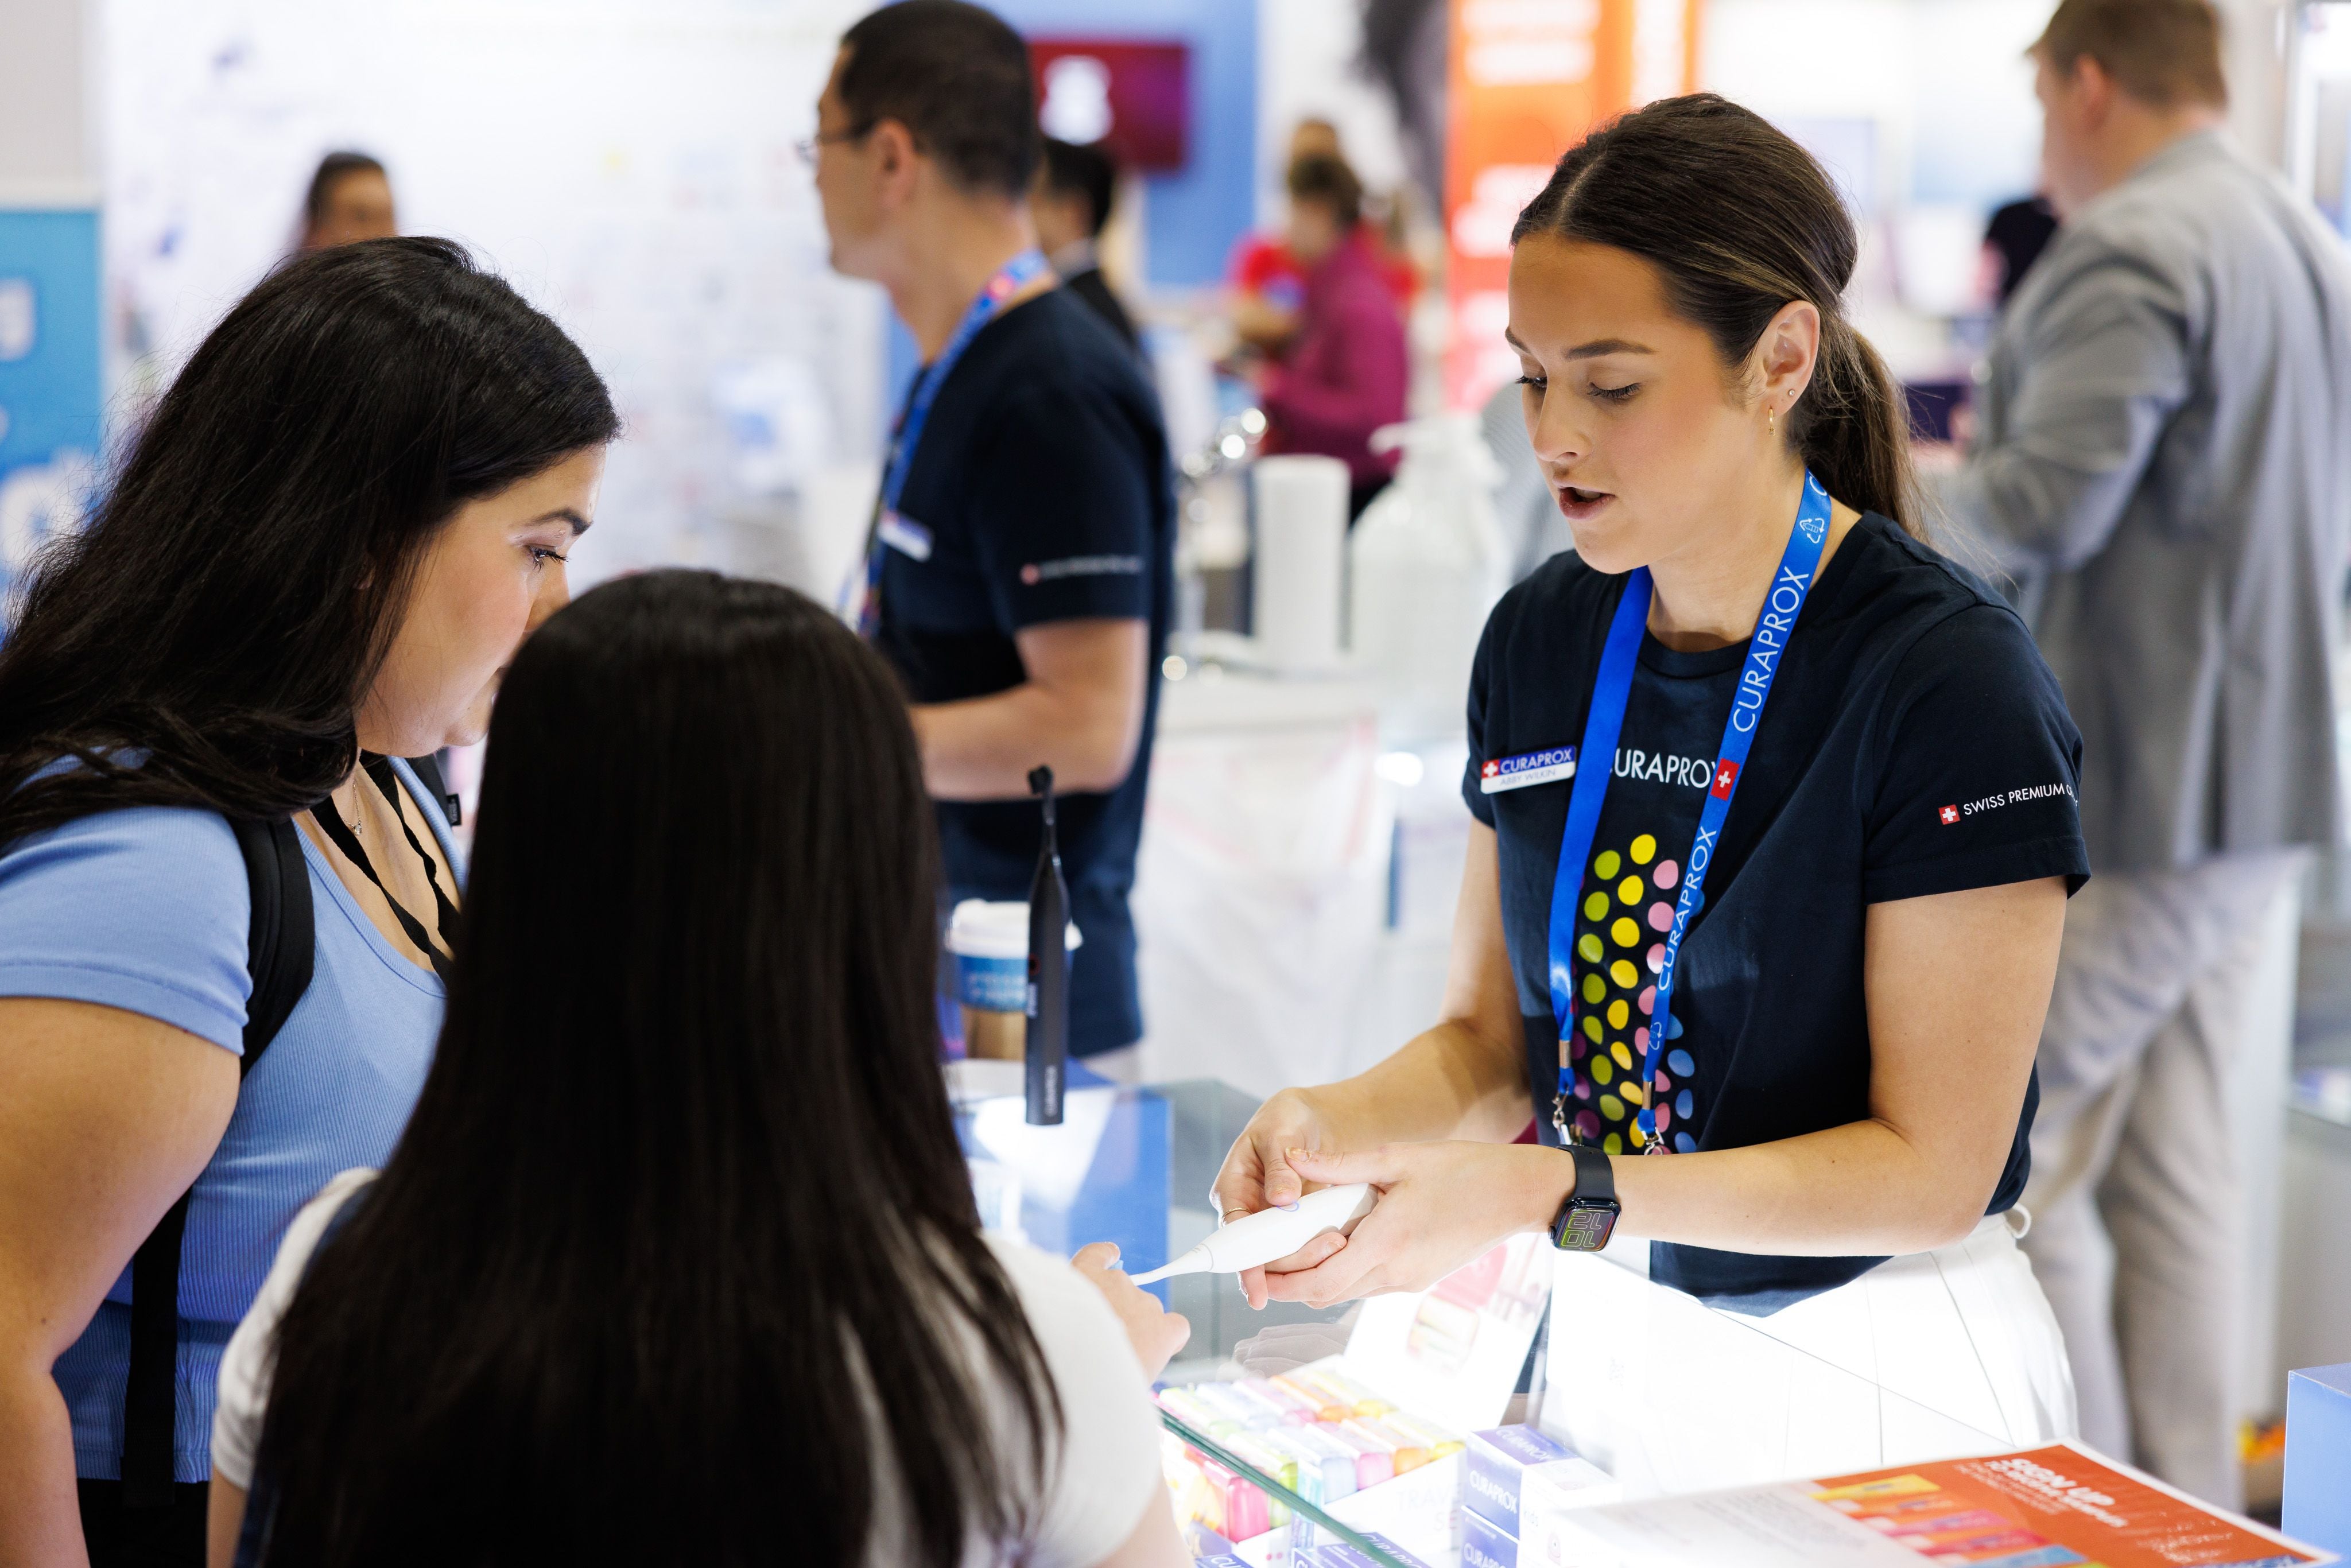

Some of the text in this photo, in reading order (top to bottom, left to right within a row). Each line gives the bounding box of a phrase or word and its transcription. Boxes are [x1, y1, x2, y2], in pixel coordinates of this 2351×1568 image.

[1733, 565, 1809, 732] CURAPROX
[1500, 748, 1572, 774] CURAPROX
[1609, 747, 1716, 789] URAPRO
[1963, 794, 2005, 816] SWISS
[2008, 782, 2065, 804] PREMIUM
[1658, 825, 1717, 991] CURAPROX
[1469, 1470, 1518, 1515] CURAPROX
